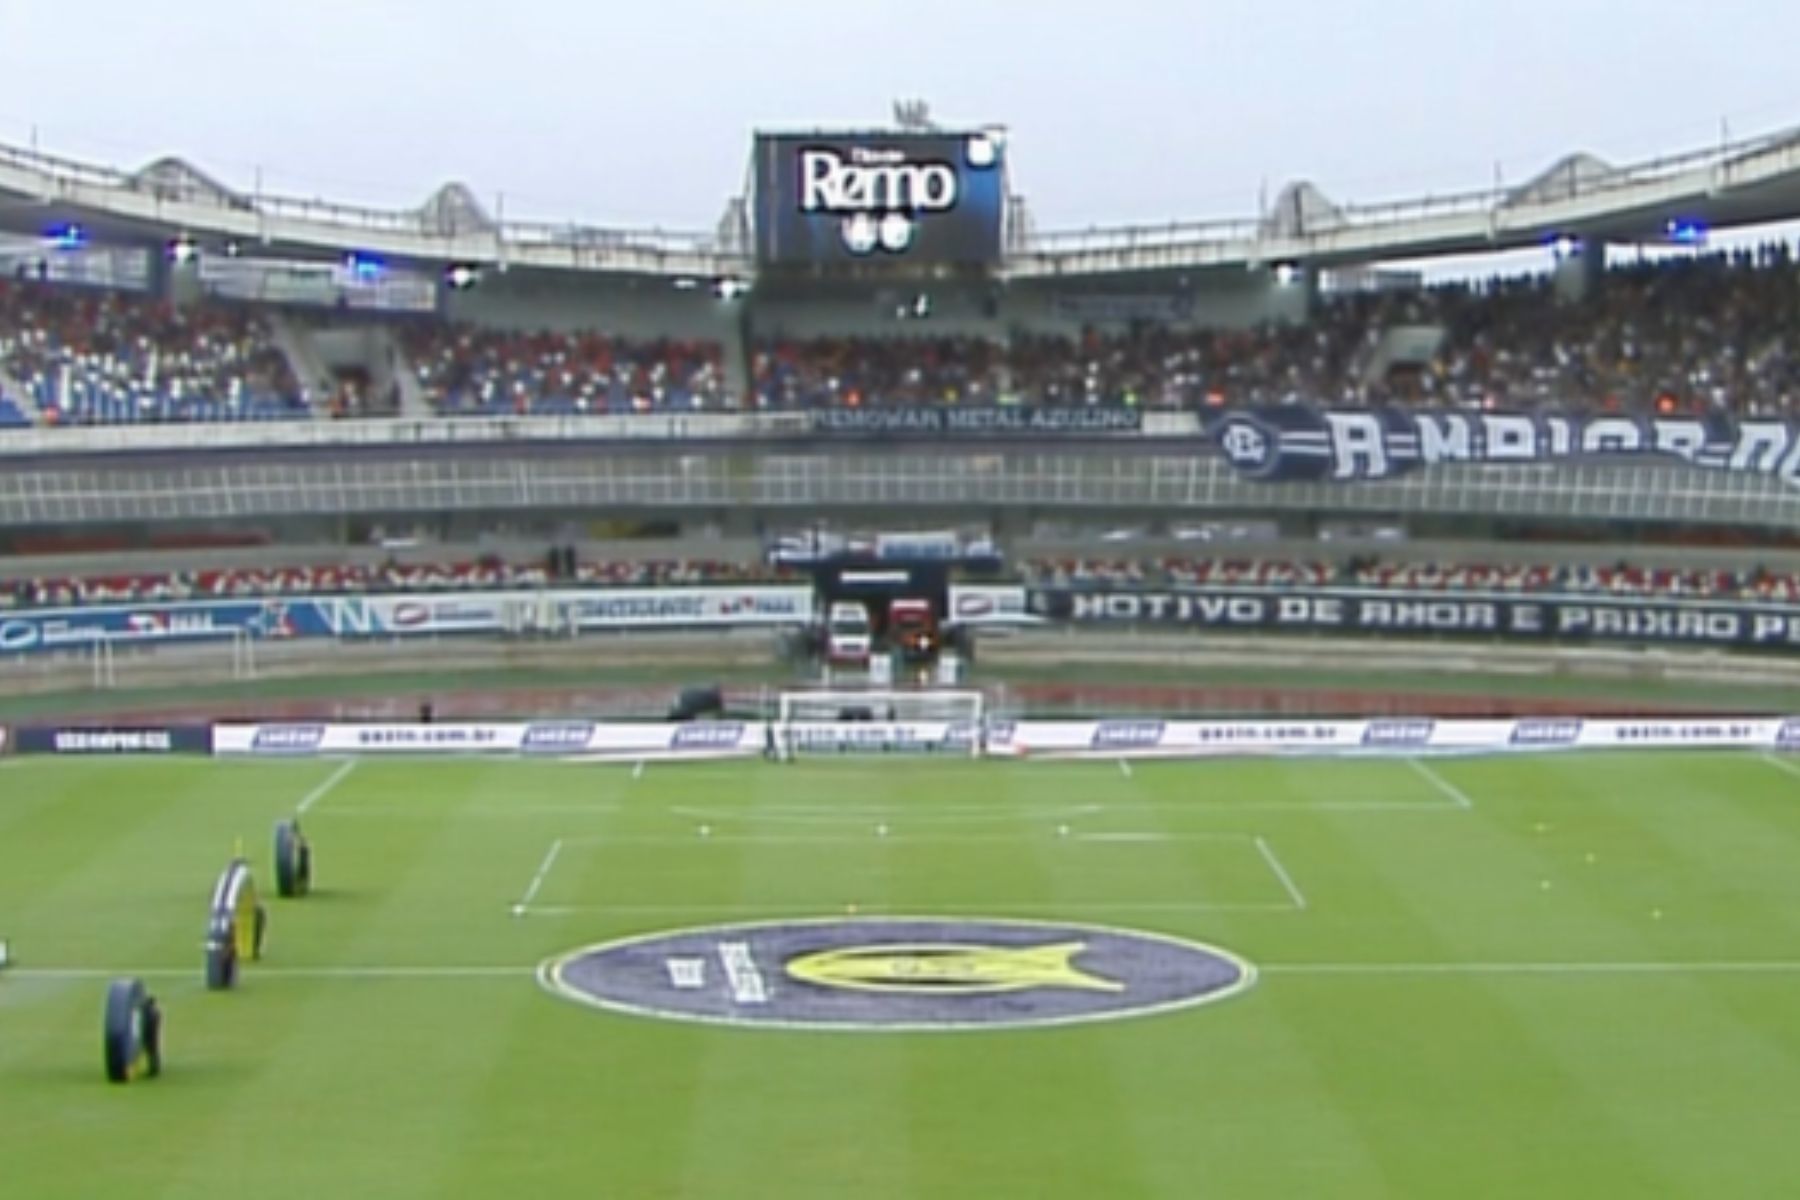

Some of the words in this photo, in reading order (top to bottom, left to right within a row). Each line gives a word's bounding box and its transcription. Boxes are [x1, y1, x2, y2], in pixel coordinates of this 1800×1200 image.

[801, 148, 956, 212] Remo
[950, 407, 1022, 428] METAL
[1277, 598, 1342, 623] DE
